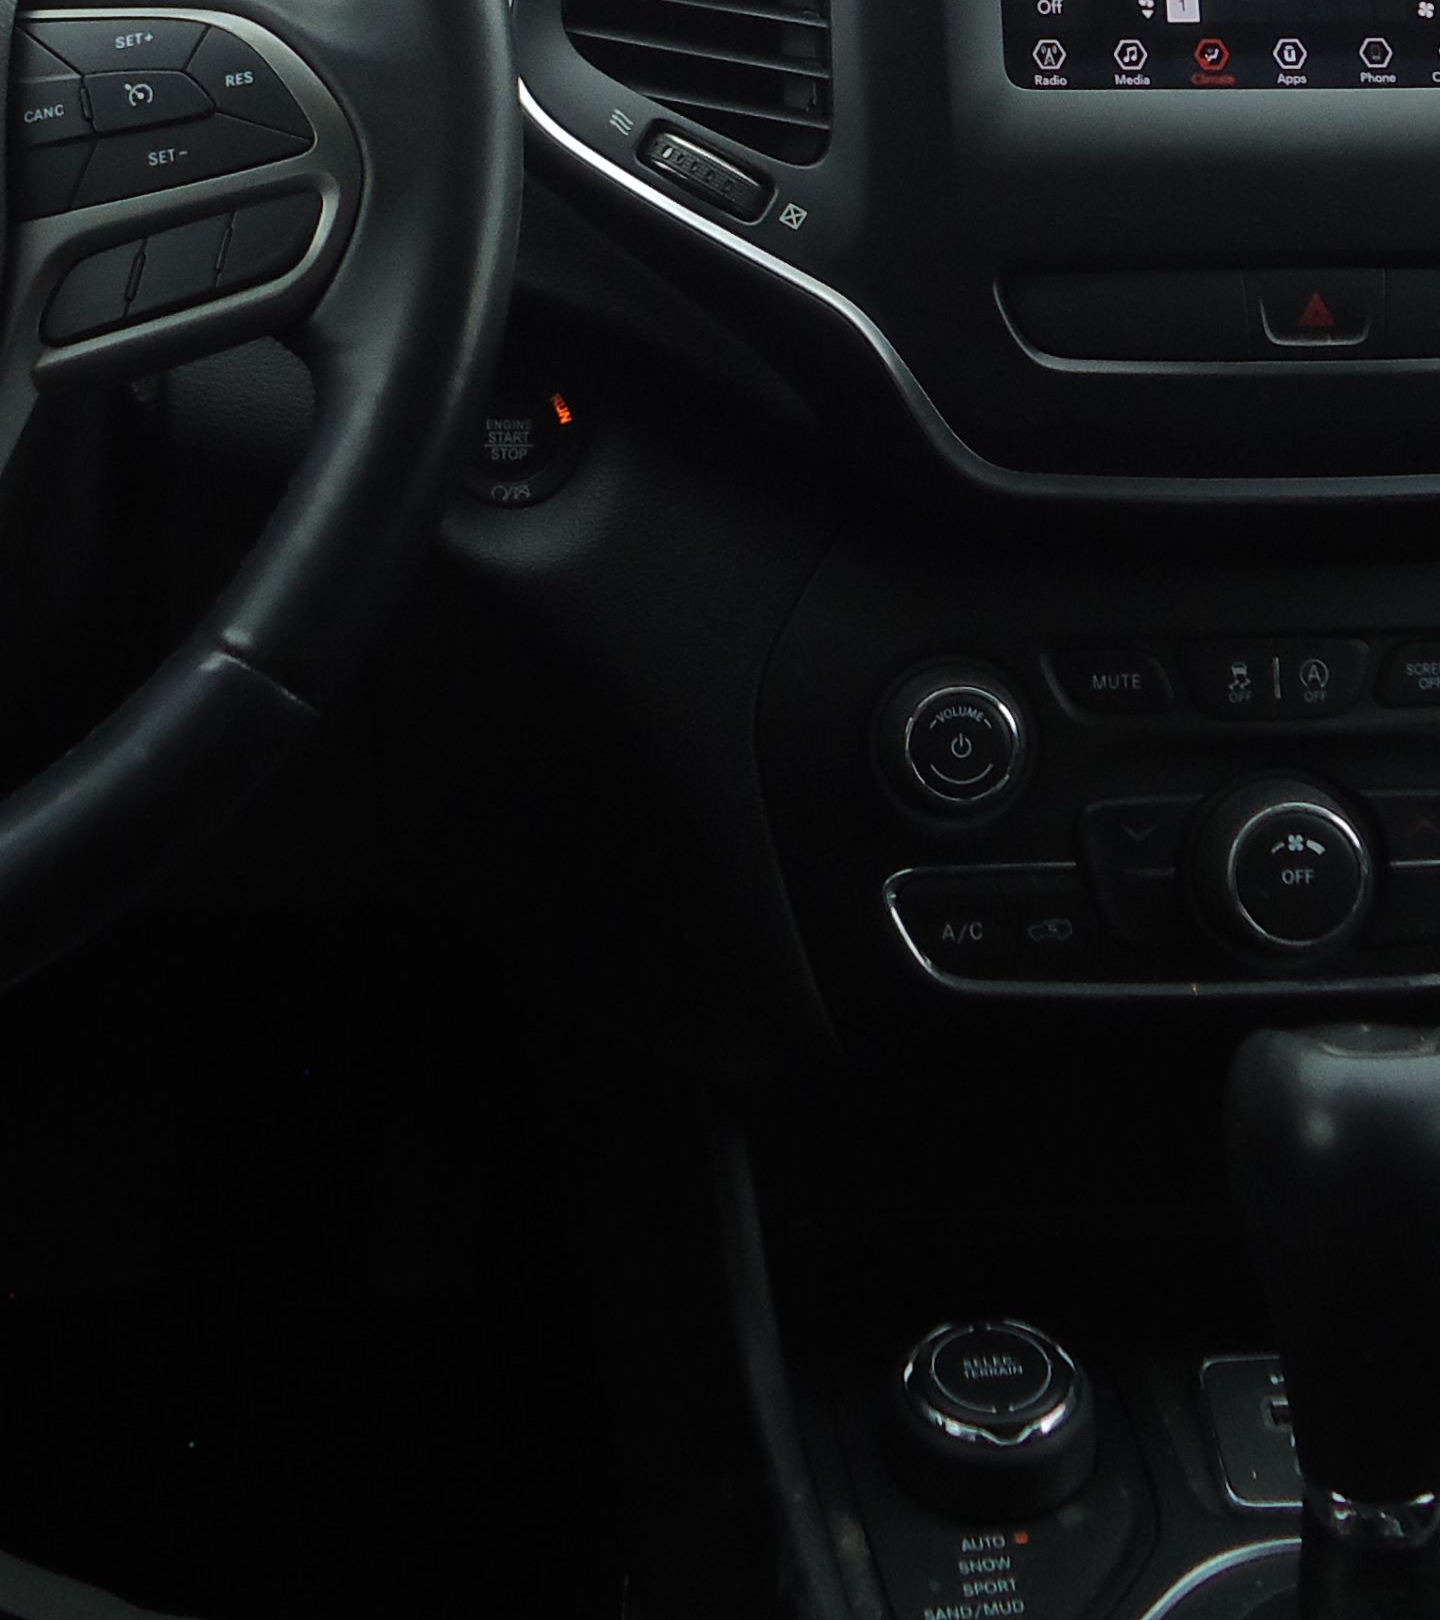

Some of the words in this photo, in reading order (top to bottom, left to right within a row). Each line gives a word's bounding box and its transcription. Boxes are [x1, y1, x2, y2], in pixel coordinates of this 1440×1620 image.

[114, 32, 154, 50] SET+
[224, 71, 255, 88] RES
[1034, 73, 1068, 86] Radio
[1114, 73, 1151, 86] Media
[1276, 72, 1308, 86] Apps
[1360, 71, 1397, 85] Phone
[23, 104, 65, 124] CANC
[486, 418, 531, 430] ENGINE
[487, 431, 529, 444] START
[490, 448, 528, 461] STOP
[1092, 674, 1143, 691] MUTE
[1303, 690, 1328, 702] OFF
[935, 705, 985, 725] VOLUME
[1281, 868, 1315, 885] OFF
[941, 921, 984, 943] A/C
[961, 1534, 1007, 1553] AUTO
[958, 1556, 1011, 1575] SNOW
[962, 1577, 1016, 1598] SPORT
[923, 1597, 1025, 1620] SAND/MUD
